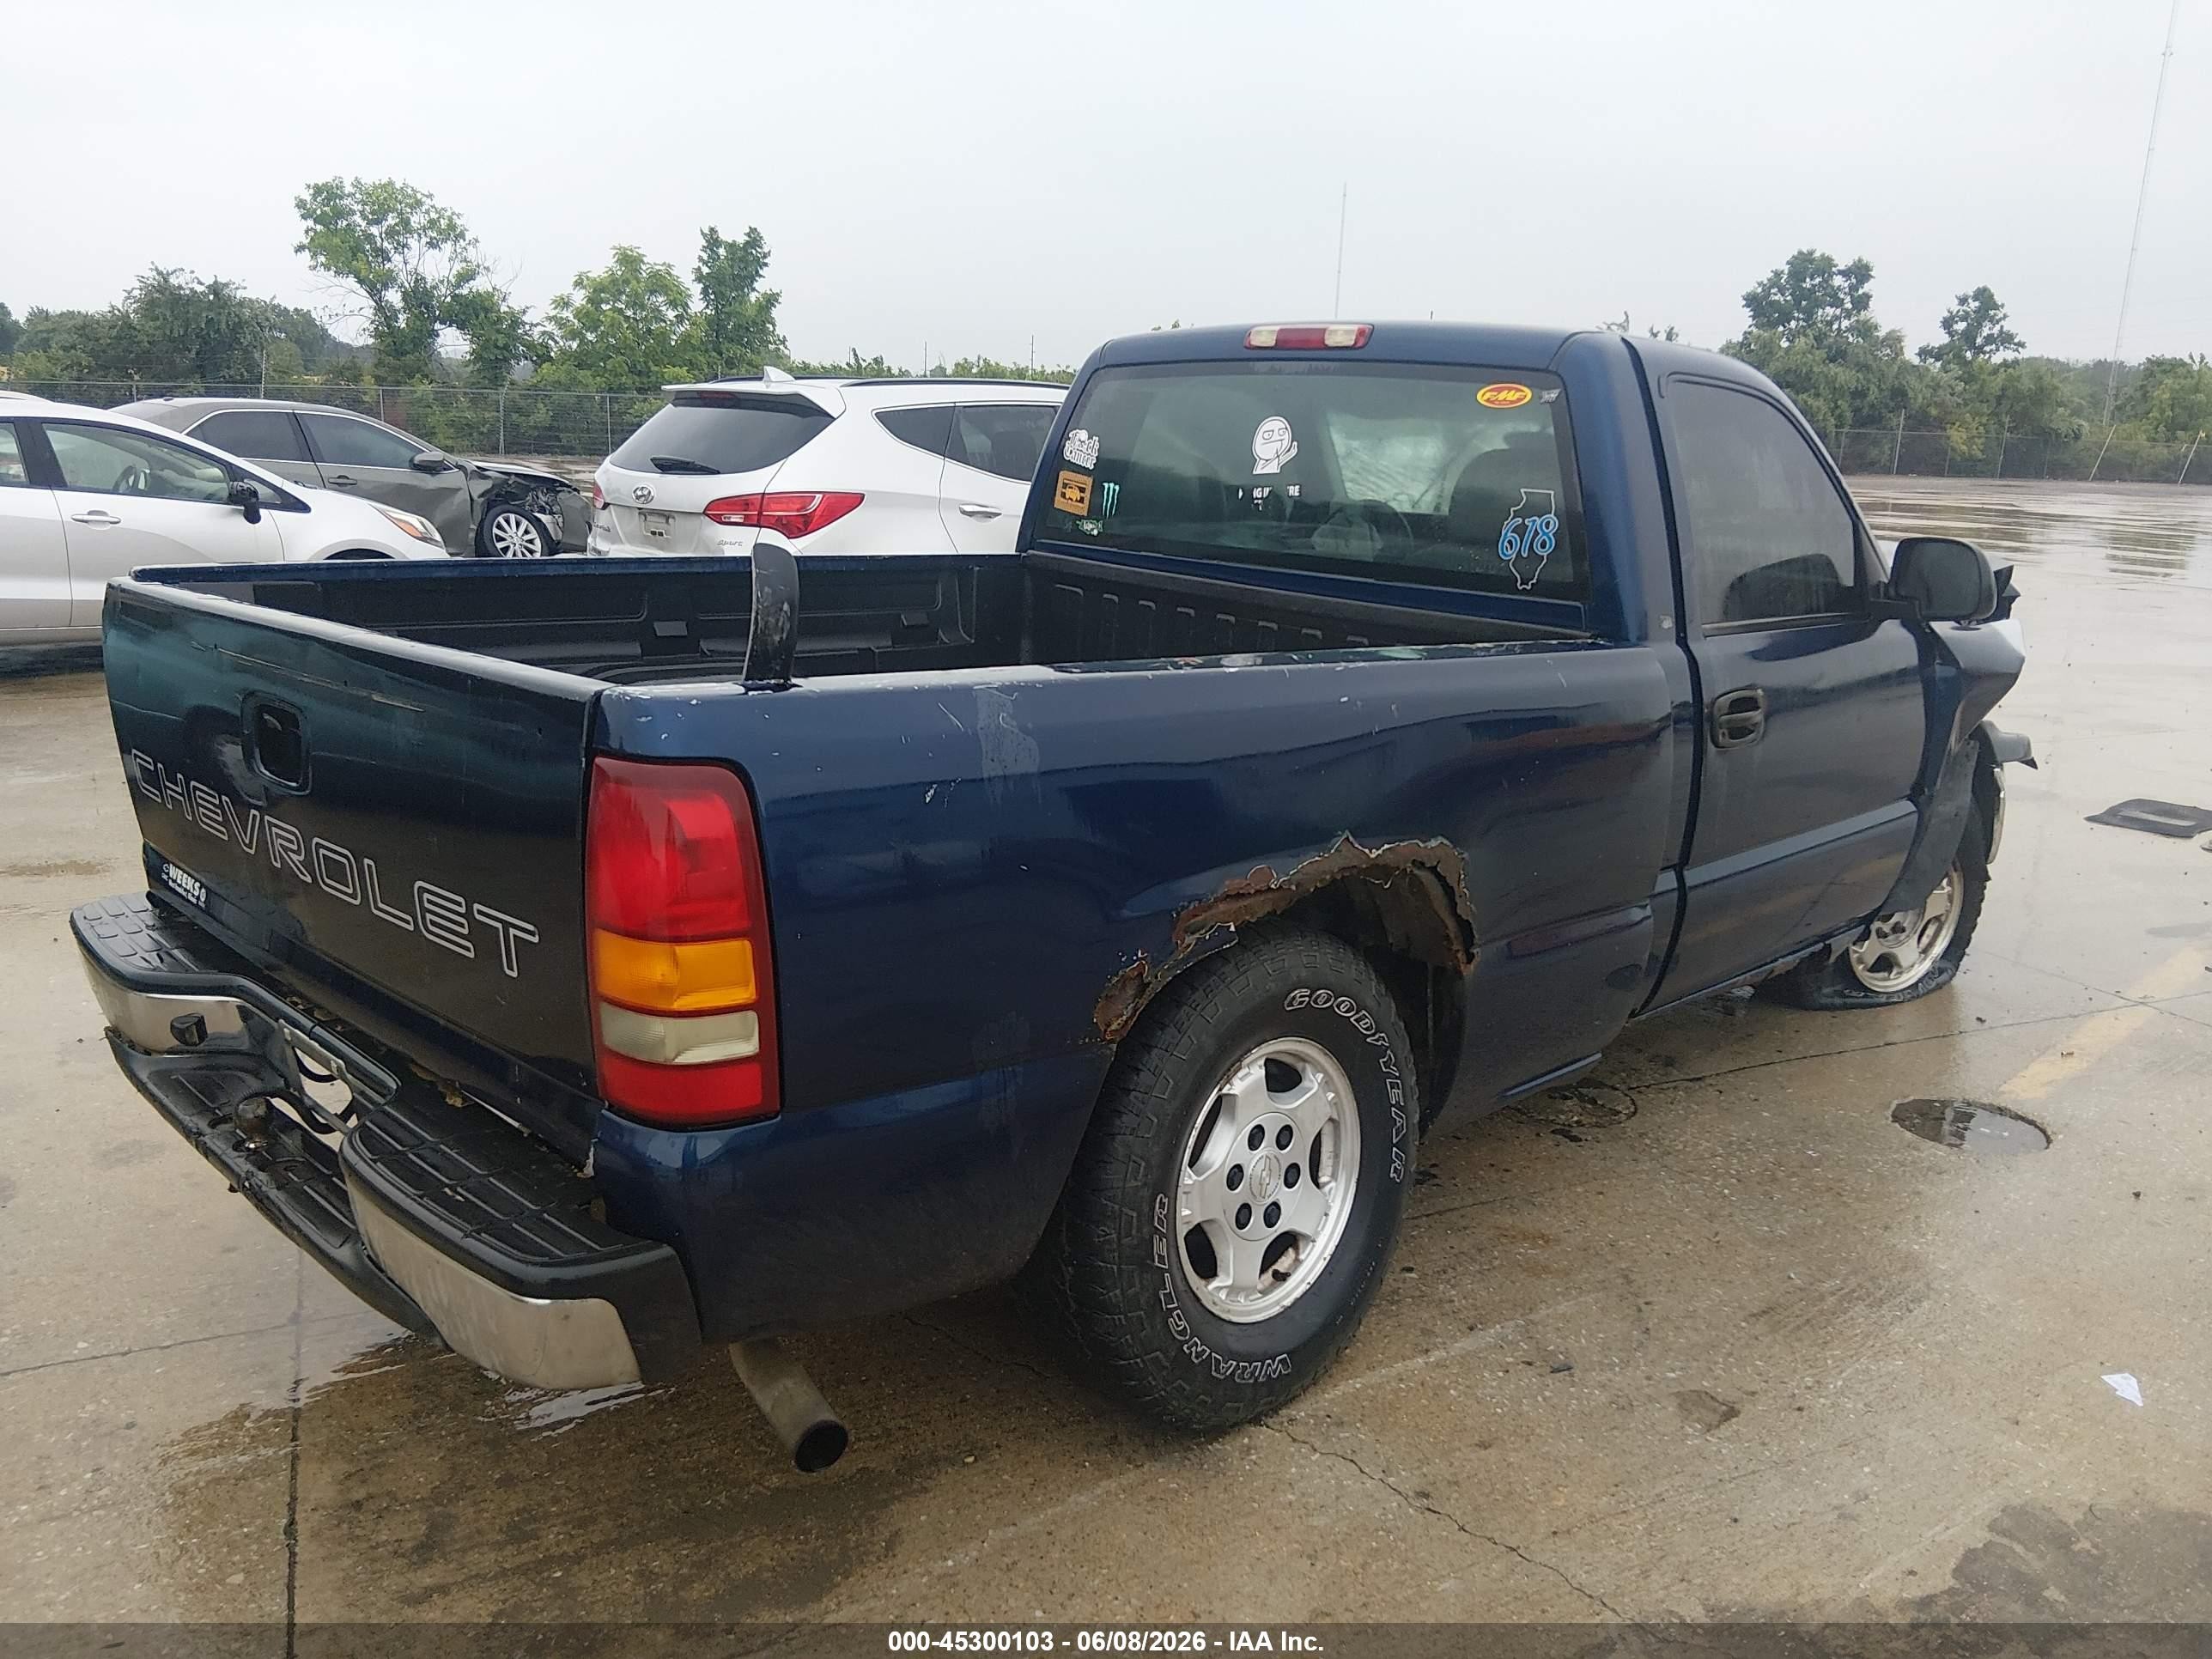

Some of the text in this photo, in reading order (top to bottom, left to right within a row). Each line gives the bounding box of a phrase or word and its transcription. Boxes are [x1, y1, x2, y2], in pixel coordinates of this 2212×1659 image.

[1481, 389, 1527, 401] FMF
[1063, 441, 1097, 471] Cancer
[1498, 514, 1559, 561] 618
[131, 748, 540, 979] CHEVROLET
[169, 862, 201, 896] WEEKS
[1283, 988, 1408, 1185] GOODYEAR
[1152, 1191, 1292, 1384] WRANGLER
